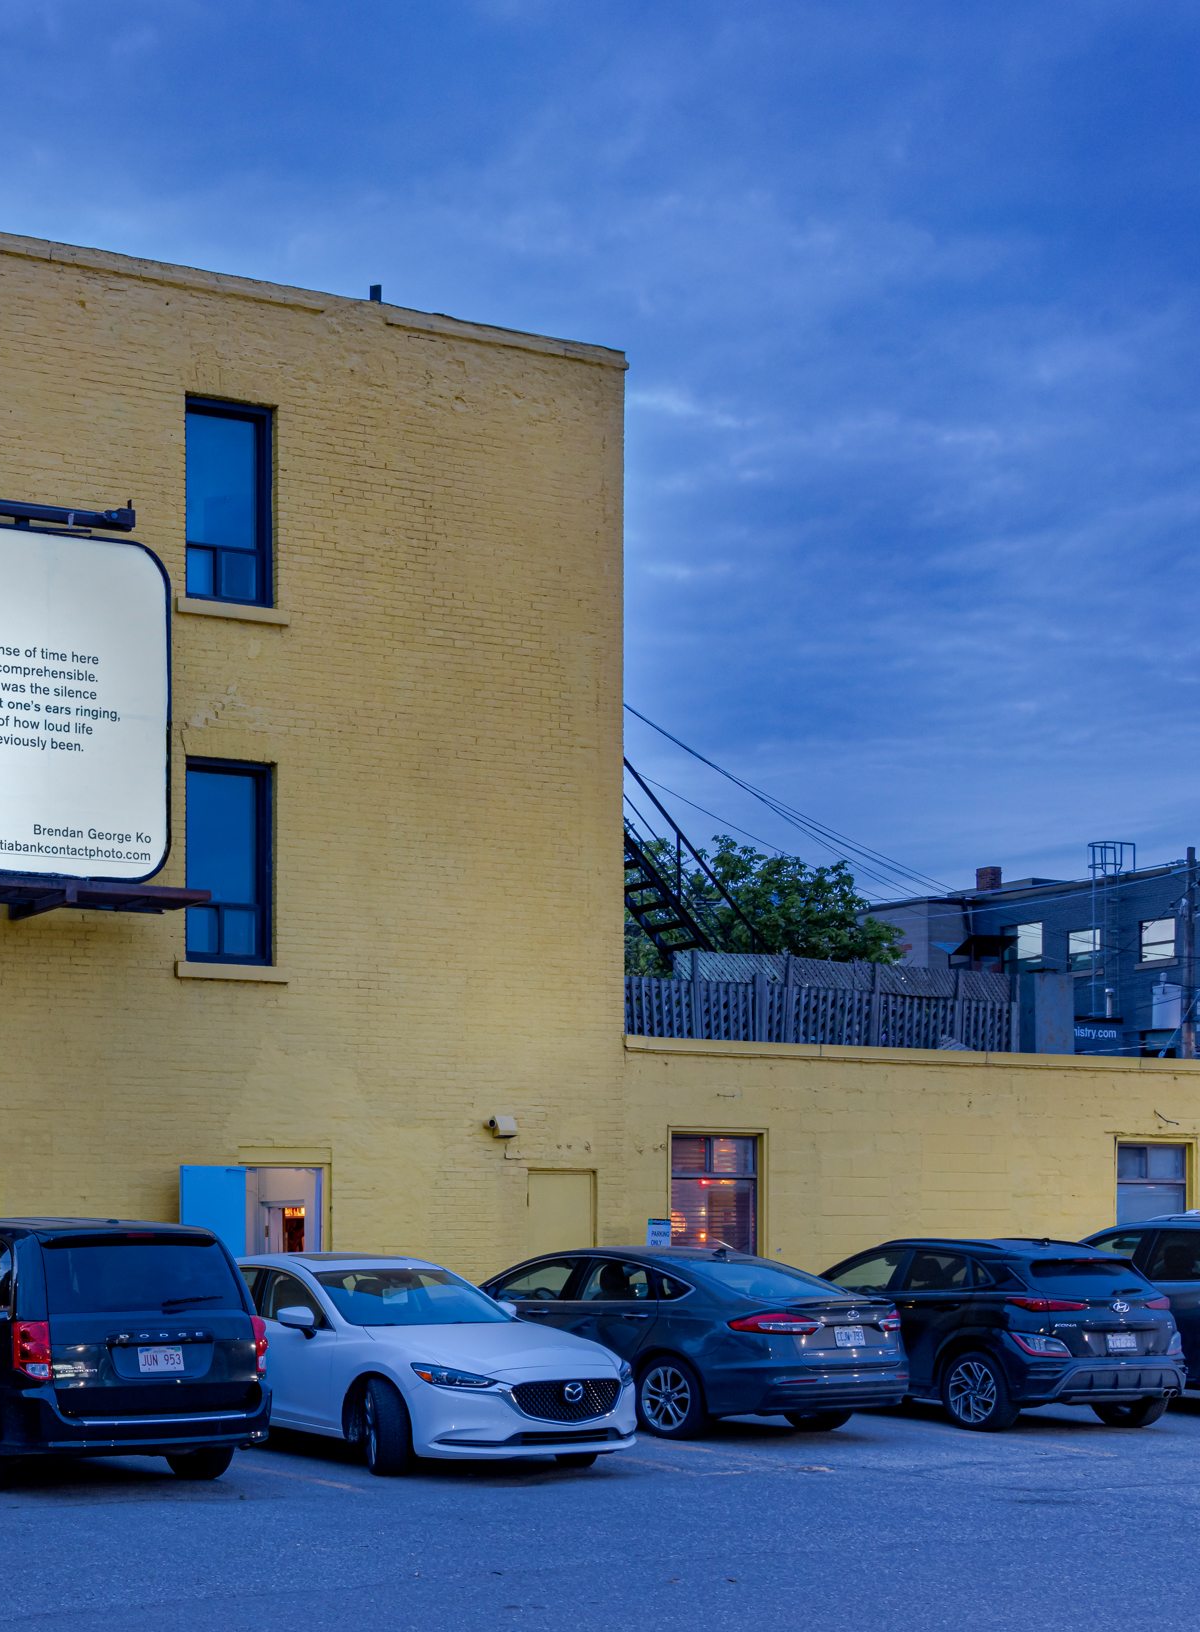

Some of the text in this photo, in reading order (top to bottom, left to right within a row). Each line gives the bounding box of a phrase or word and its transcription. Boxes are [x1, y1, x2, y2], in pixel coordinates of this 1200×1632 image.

[24, 647, 37, 659] of
[40, 648, 68, 662] time
[71, 651, 99, 665] here
[1, 682, 26, 693] was
[30, 683, 50, 695] the
[53, 686, 98, 700] silence
[7, 700, 41, 712] one's
[45, 704, 71, 715] ears
[75, 707, 121, 722] ringing,
[13, 716, 40, 730] how
[44, 719, 71, 733] loud
[74, 722, 93, 735] life
[50, 738, 84, 752] been.
[33, 823, 152, 844] Brendan George Ko
[651, 1230, 670, 1238] PARKING
[119, 1331, 203, 1339] DODGE
[141, 1353, 182, 1367] JUN 953
